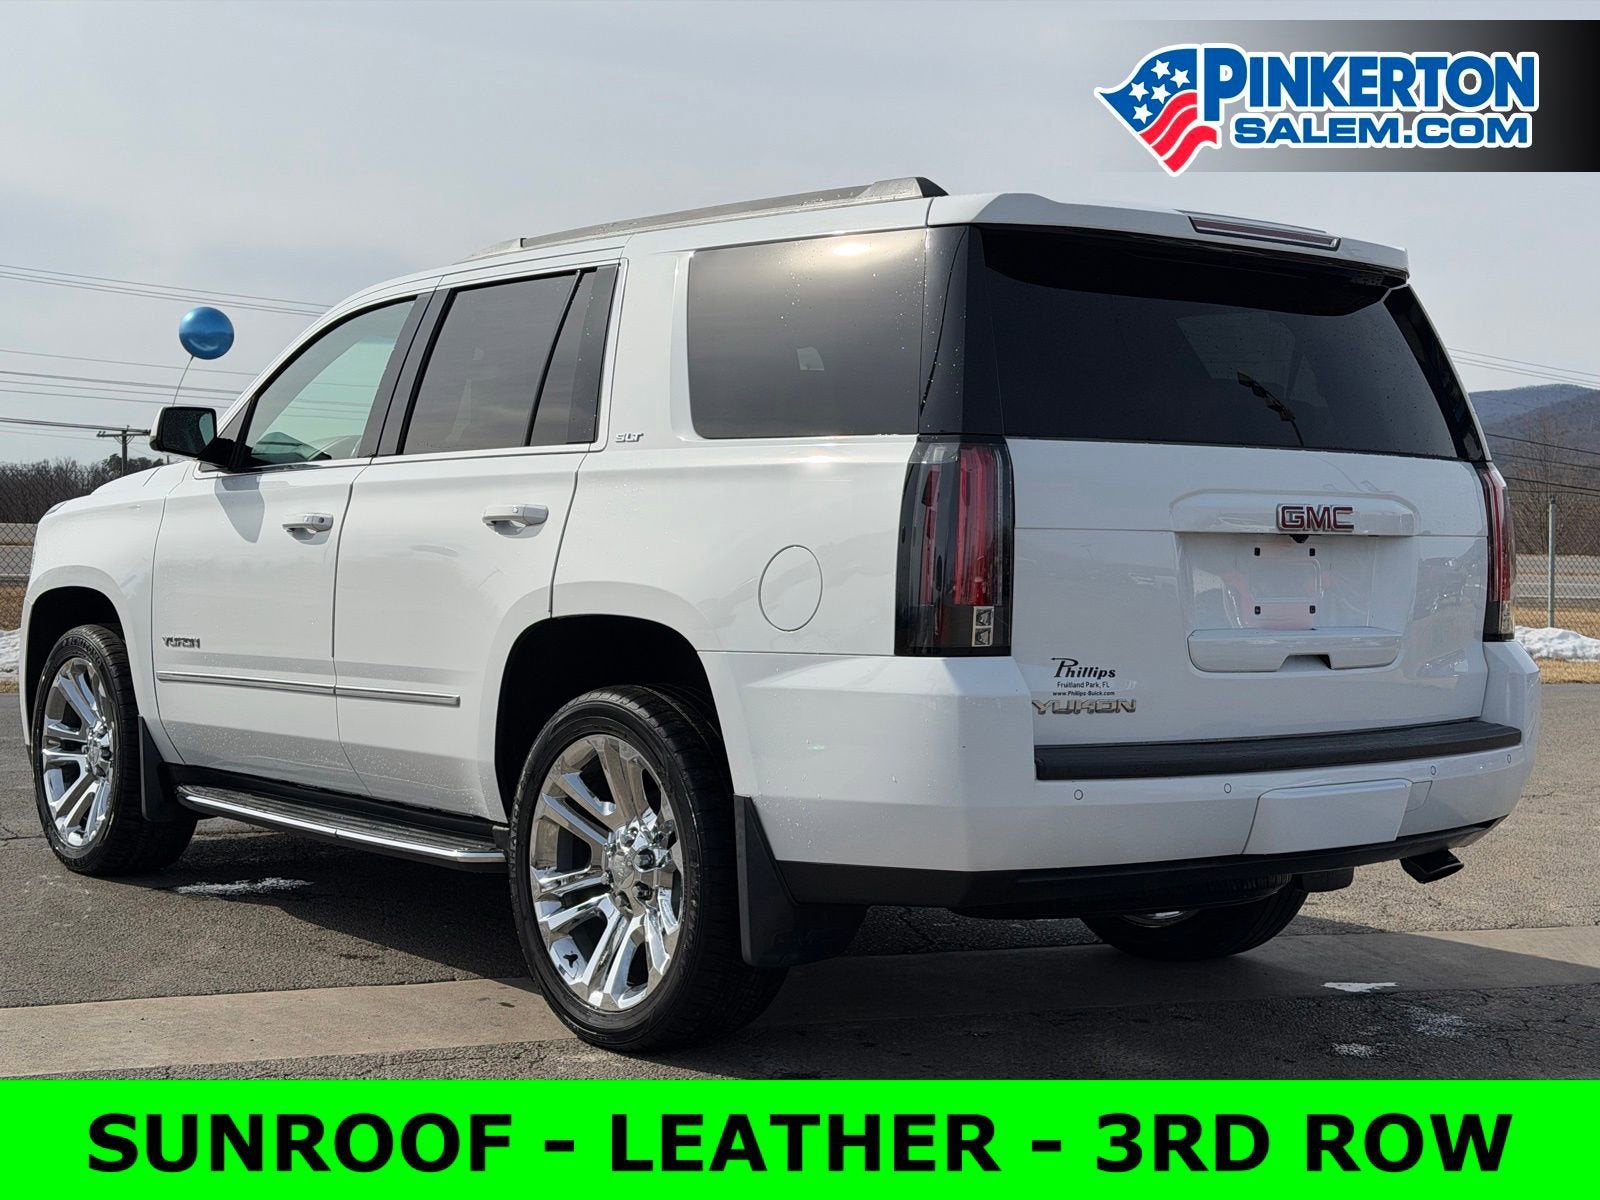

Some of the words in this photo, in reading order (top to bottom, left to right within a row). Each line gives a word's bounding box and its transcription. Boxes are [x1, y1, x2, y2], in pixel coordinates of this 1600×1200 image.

[615, 432, 645, 443] SLT
[1276, 503, 1355, 532] GMC
[1051, 657, 1117, 680] Phillips
[1056, 681, 1085, 689] Fruitland
[1085, 681, 1101, 689] Park,
[1102, 681, 1110, 689] FL
[1031, 698, 1137, 715] YUKON
